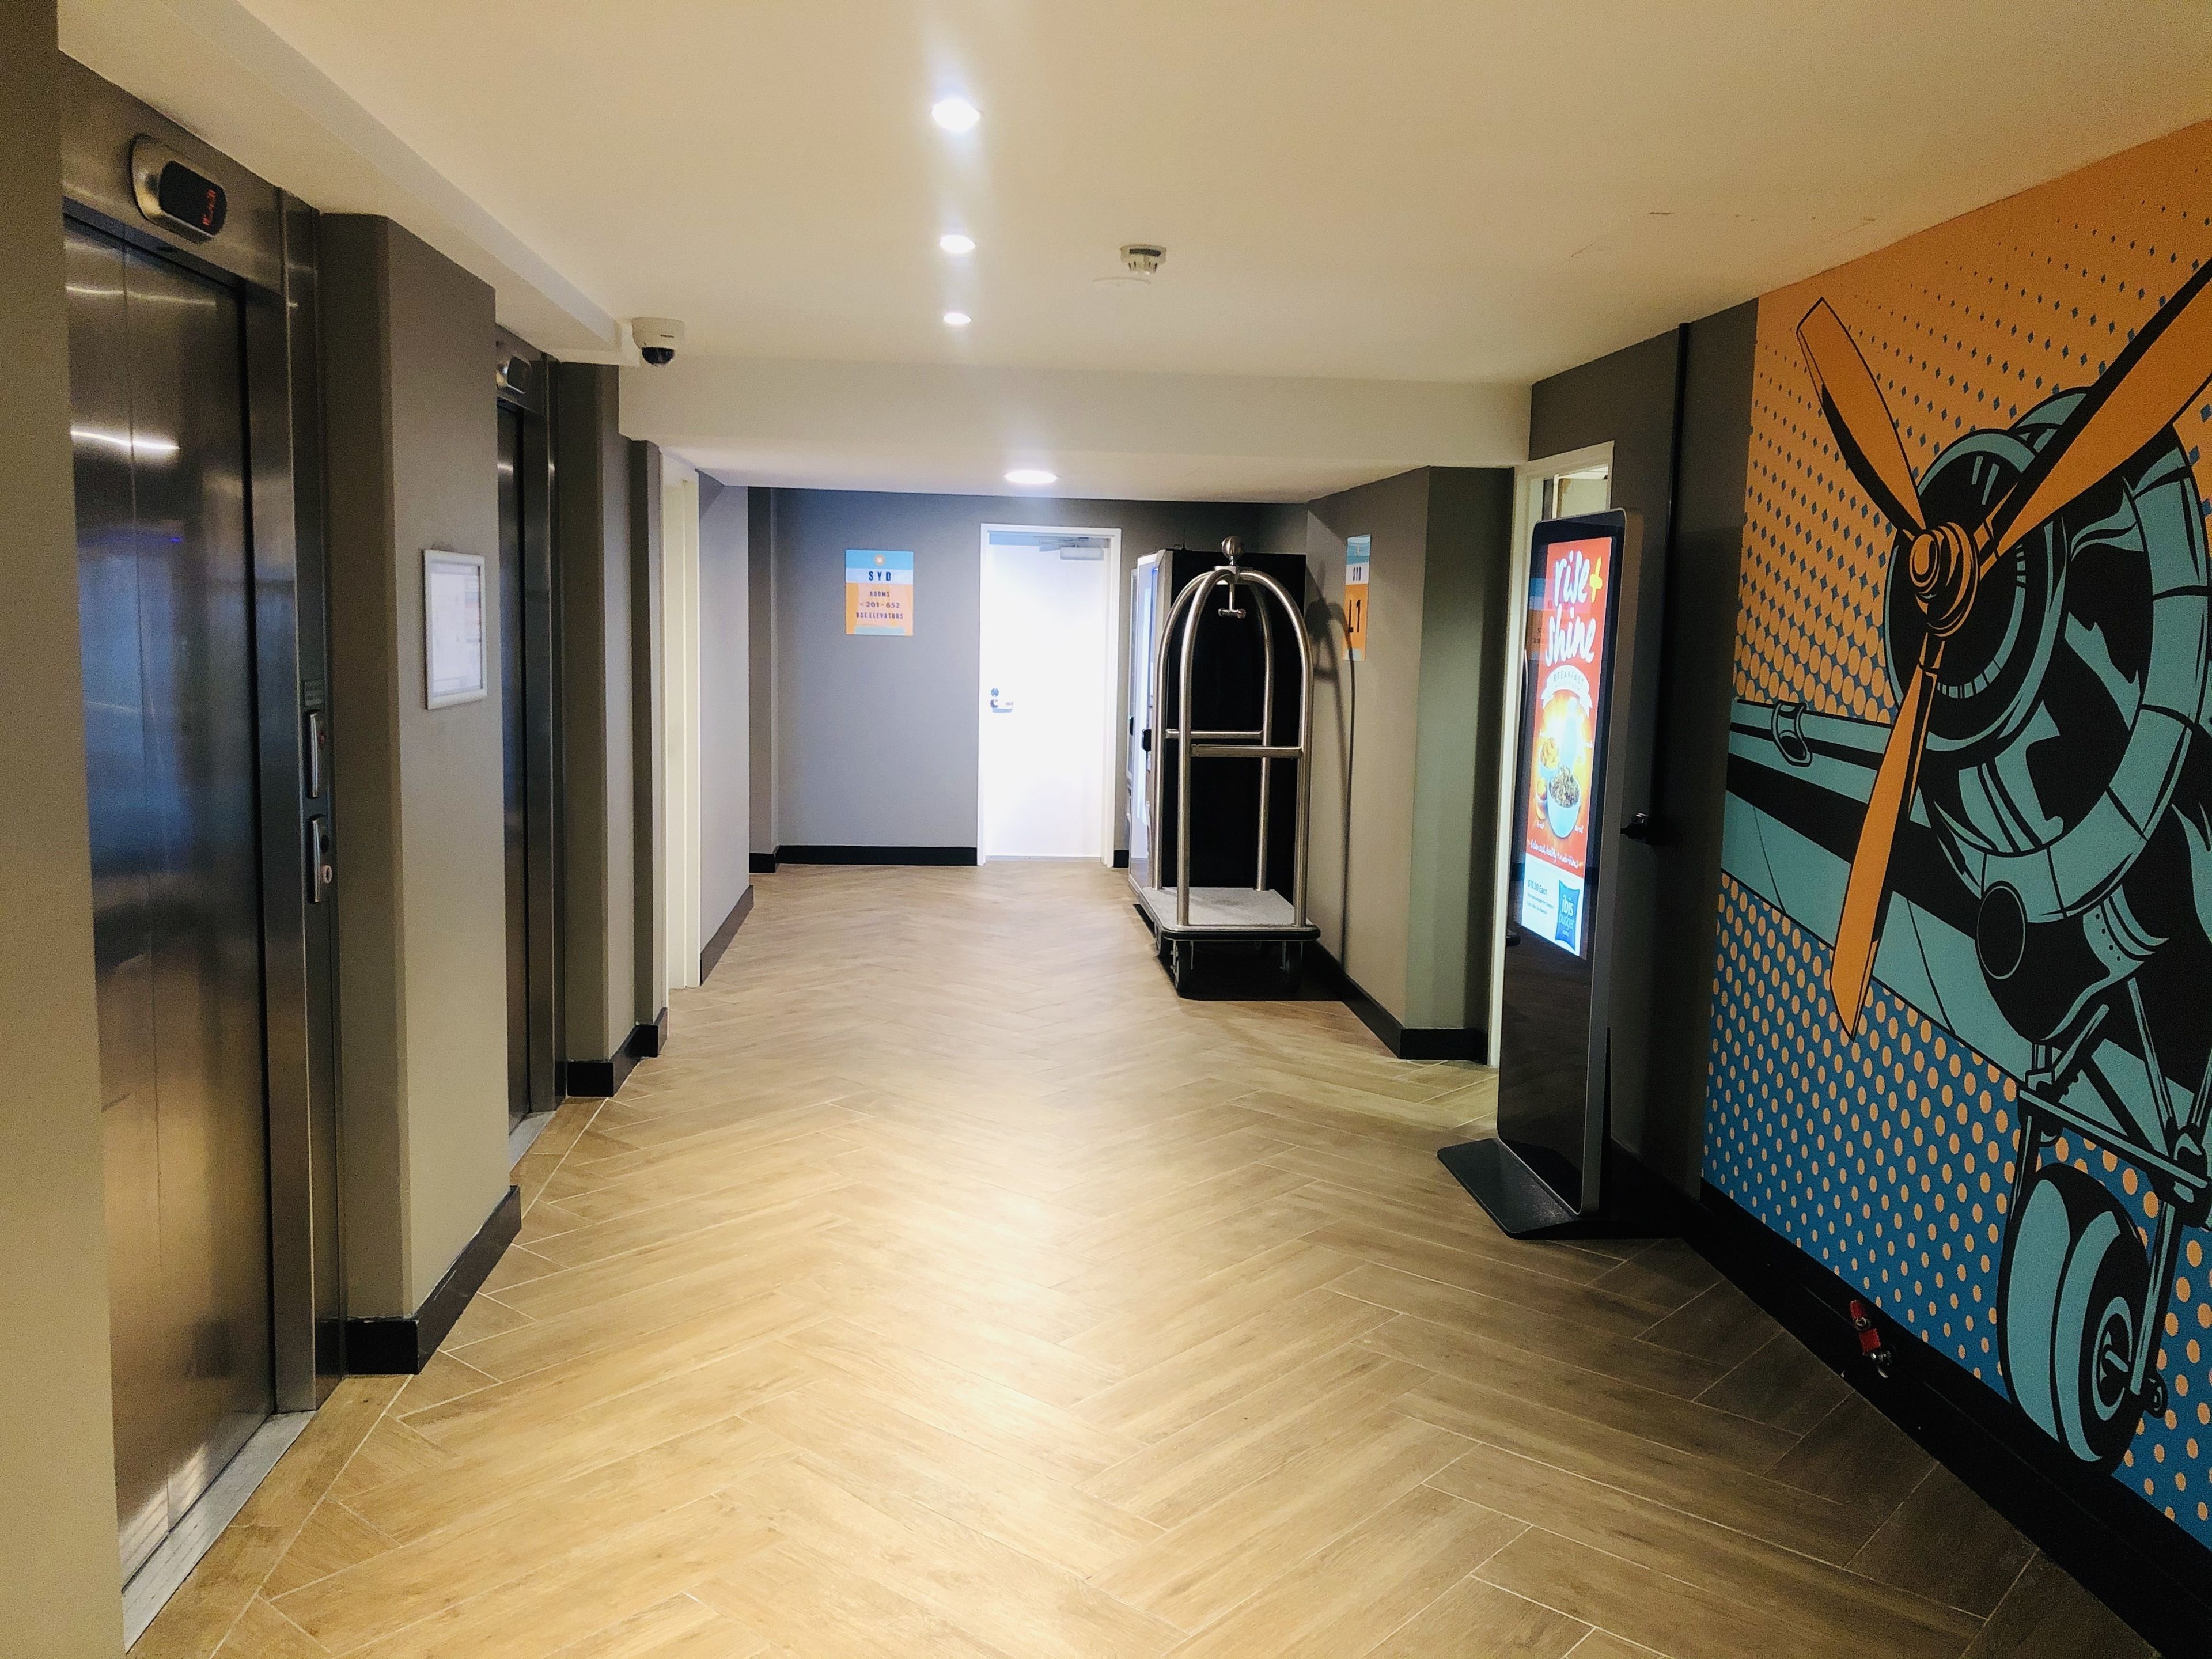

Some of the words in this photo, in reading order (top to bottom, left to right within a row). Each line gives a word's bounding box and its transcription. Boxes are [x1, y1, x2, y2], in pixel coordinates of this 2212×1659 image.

[868, 571, 891, 581] SYD
[1554, 550, 1590, 607] rise
[1347, 599, 1361, 633] L1
[1545, 603, 1596, 667] shine
[1562, 894, 1574, 916] ibis
[1559, 912, 1575, 930] budget
